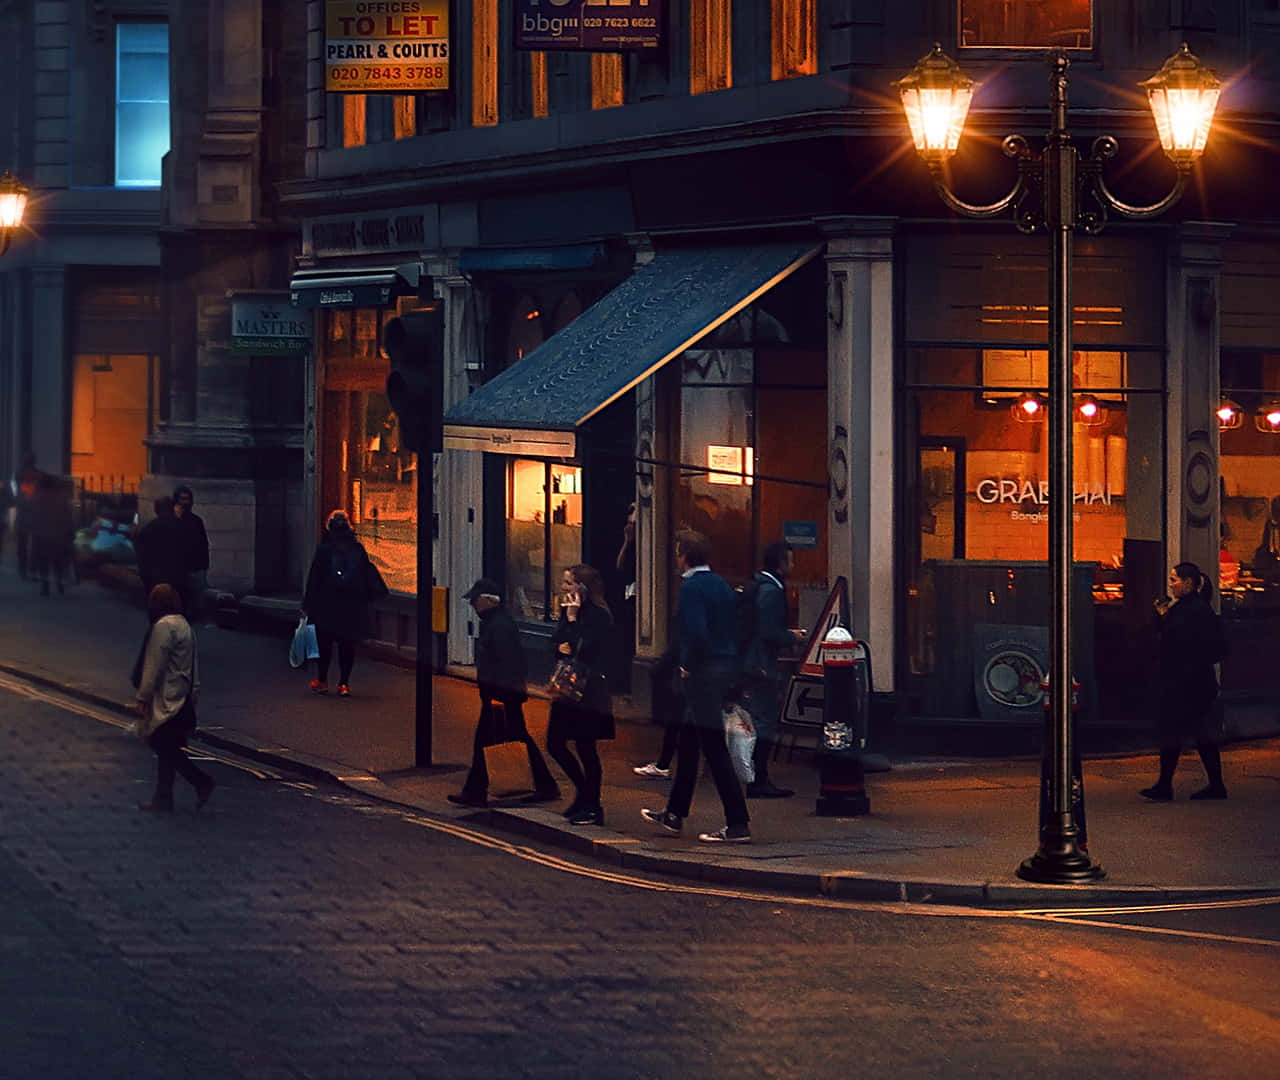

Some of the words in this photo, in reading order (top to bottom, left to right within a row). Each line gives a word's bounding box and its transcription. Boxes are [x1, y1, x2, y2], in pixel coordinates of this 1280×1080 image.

[356, 1, 421, 14] OFFICES
[337, 16, 376, 36] TO
[386, 15, 440, 36] LET
[327, 44, 374, 59] PEARL
[377, 43, 388, 58] &
[393, 42, 448, 58] COUTTS
[331, 67, 359, 80] 020
[364, 67, 402, 80] 7843
[406, 66, 444, 79] 3788
[236, 319, 306, 336] MASTERS
